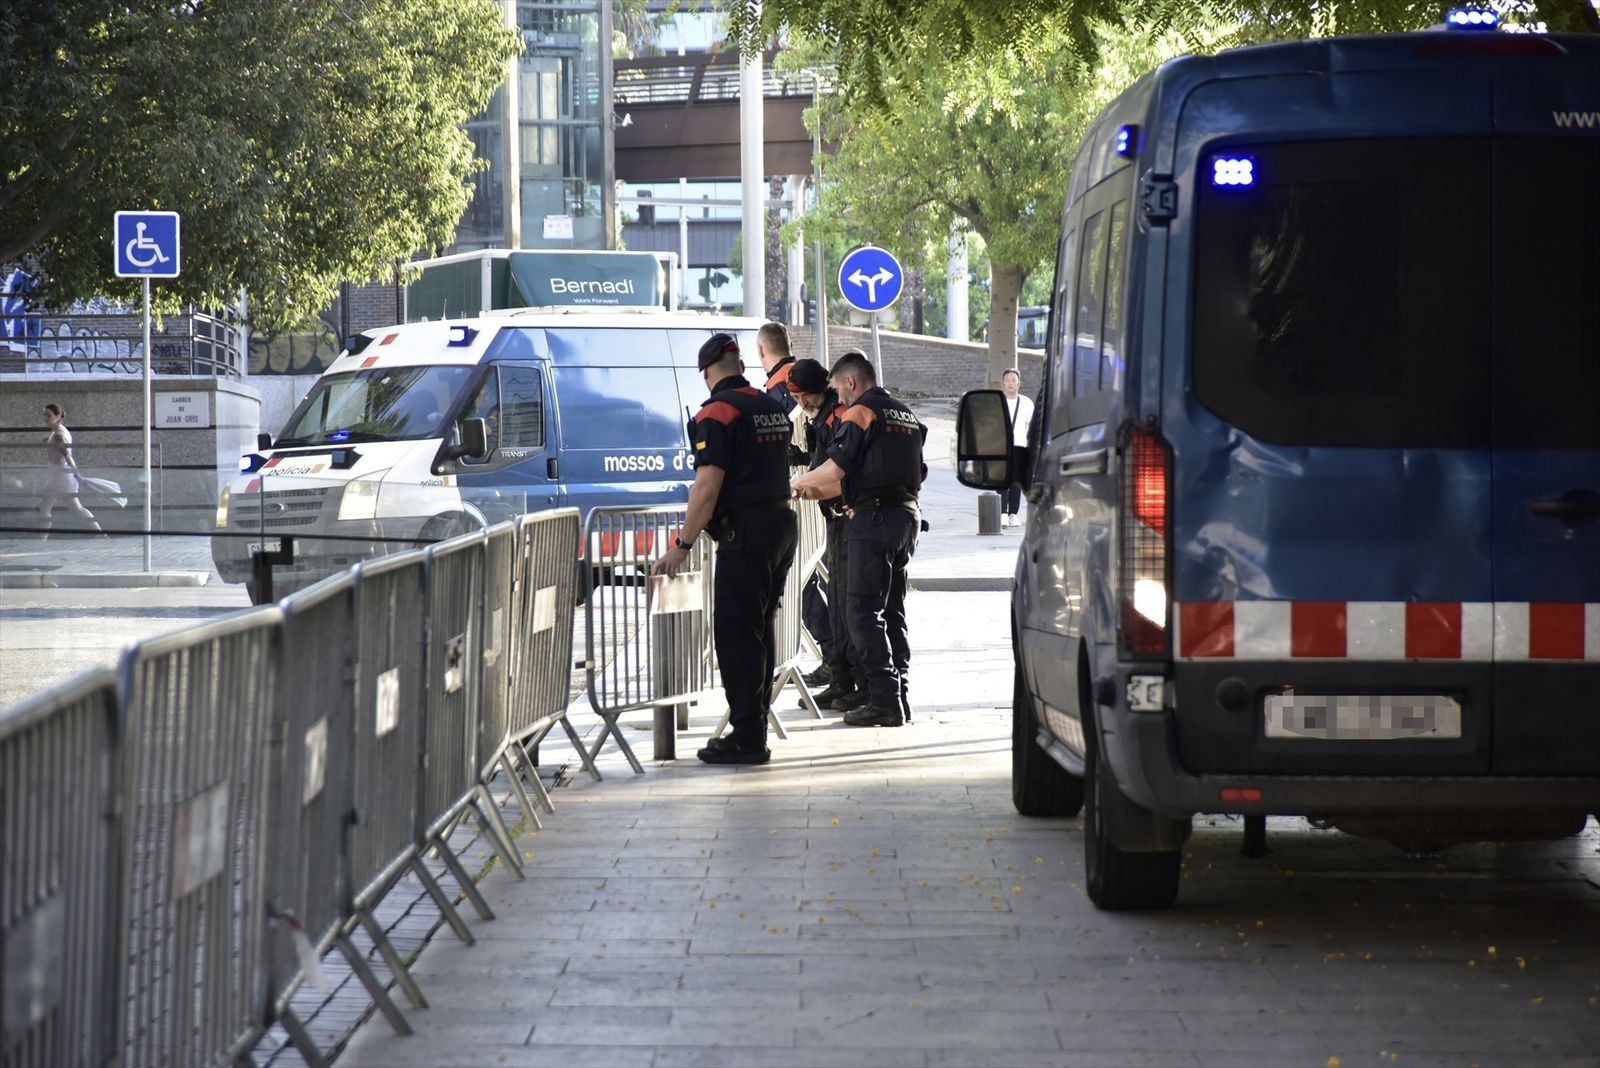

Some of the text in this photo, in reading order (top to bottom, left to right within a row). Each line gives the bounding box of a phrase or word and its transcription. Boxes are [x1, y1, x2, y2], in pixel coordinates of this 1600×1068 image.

[1552, 111, 1600, 127] ww
[166, 415, 199, 423] JUAN GRIS
[753, 413, 788, 427] POLICIA
[883, 408, 919, 424] POLICIA
[501, 450, 528, 458] TRANSIT
[604, 455, 665, 472] mossos
[266, 466, 311, 478] policia
[420, 478, 444, 488] policia
